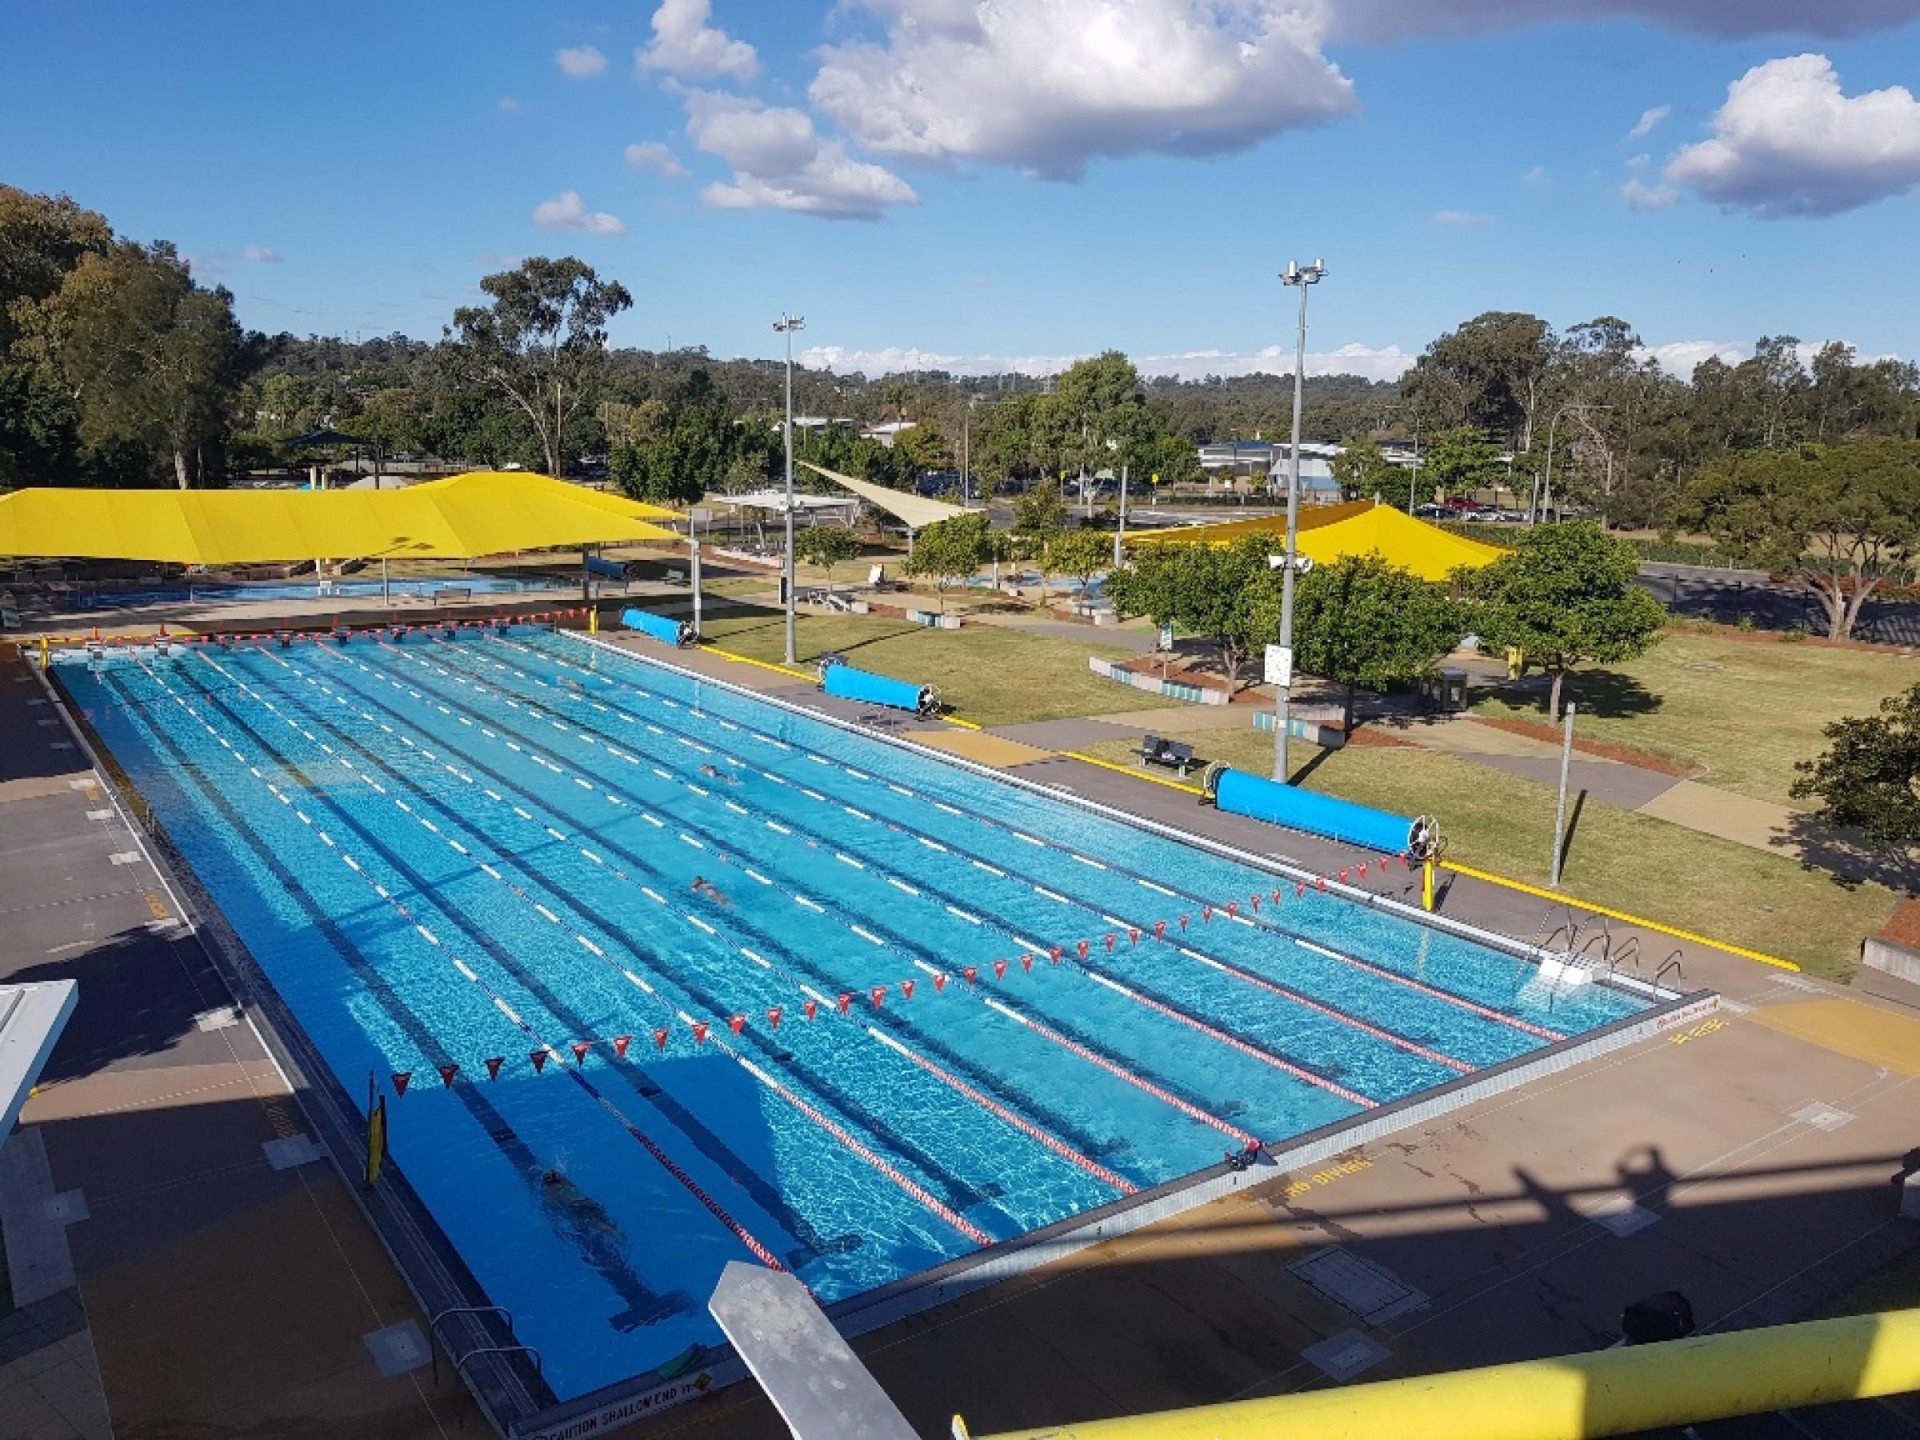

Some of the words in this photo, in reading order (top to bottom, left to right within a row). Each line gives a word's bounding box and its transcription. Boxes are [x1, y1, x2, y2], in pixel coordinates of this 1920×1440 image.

[549, 1416, 597, 1440] CAUTION
[602, 1396, 652, 1426] SHALLOW
[654, 1387, 677, 1405] END
